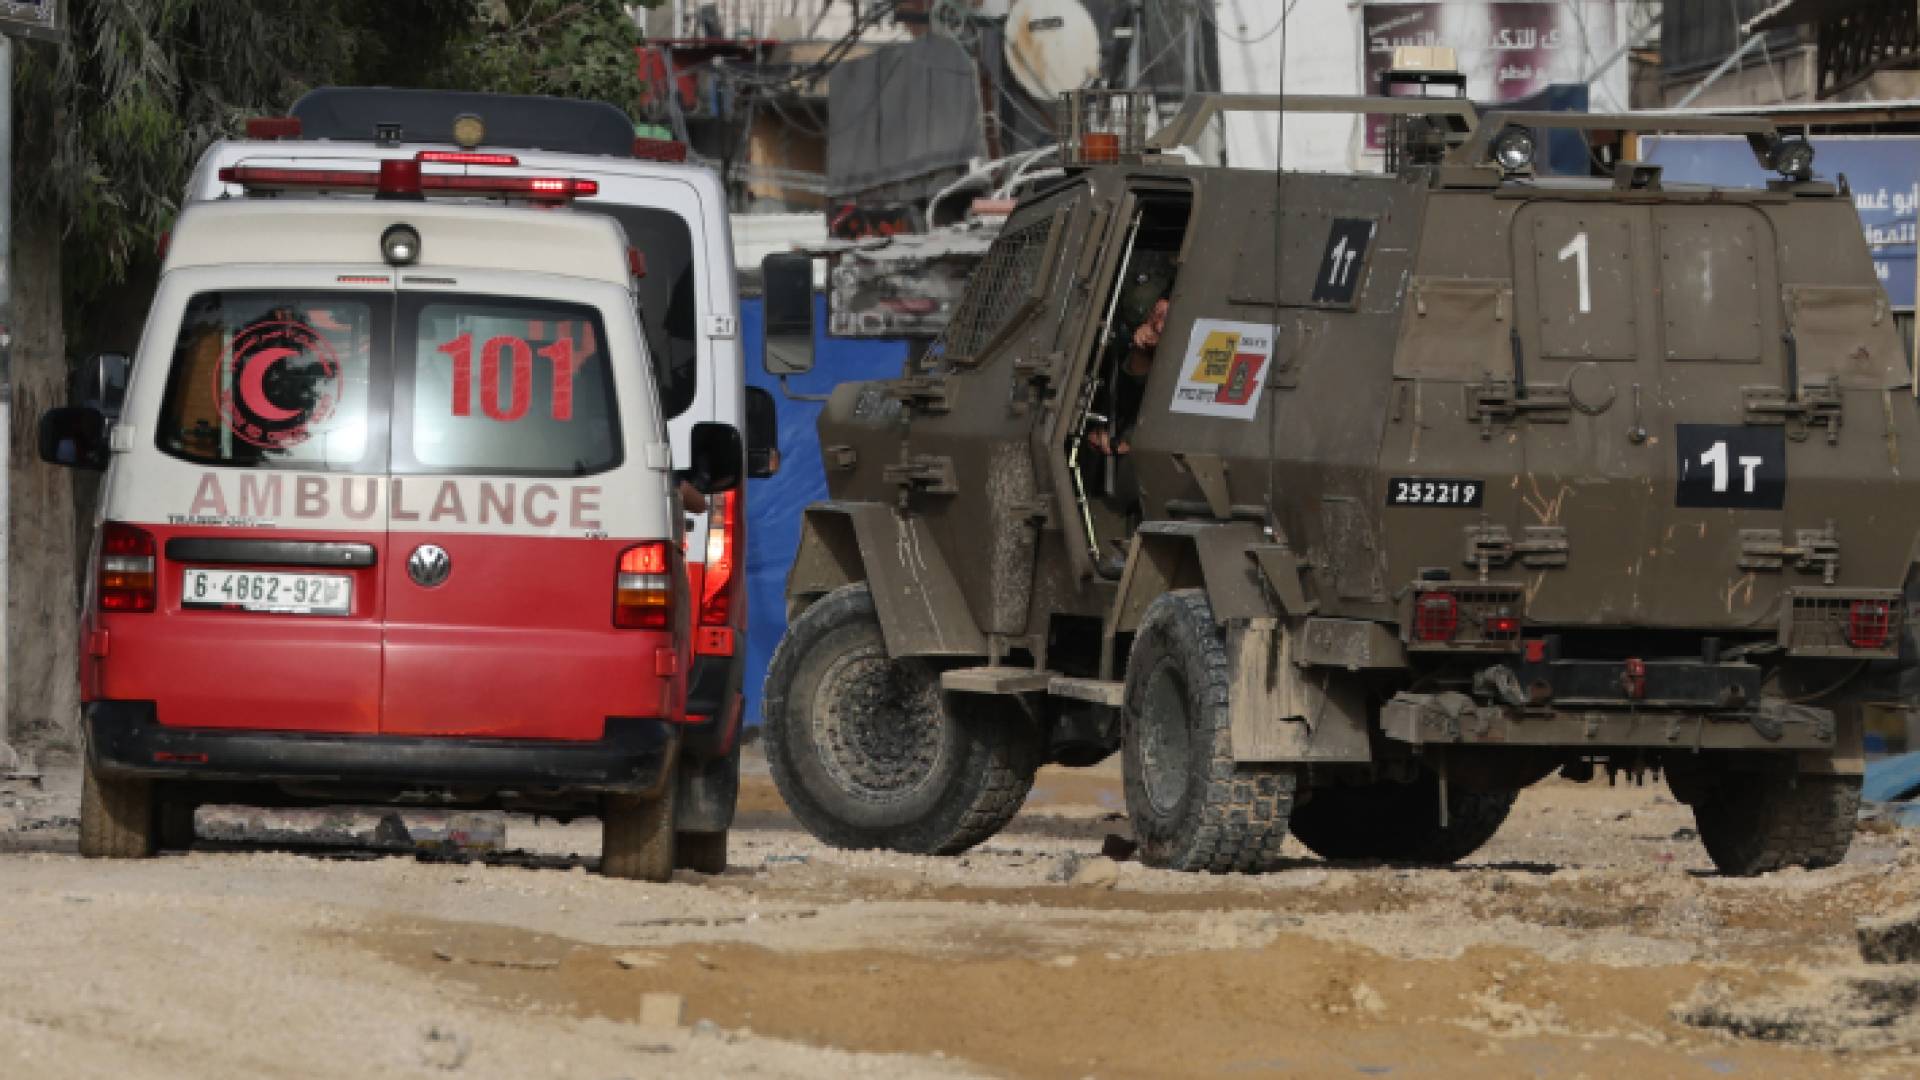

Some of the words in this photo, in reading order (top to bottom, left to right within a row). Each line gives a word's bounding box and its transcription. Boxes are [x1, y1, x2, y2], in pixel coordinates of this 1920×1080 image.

[1558, 231, 1591, 313] 1
[437, 330, 573, 422] 101
[189, 472, 602, 529] AMBULANCE
[1395, 482, 1476, 503] 252219
